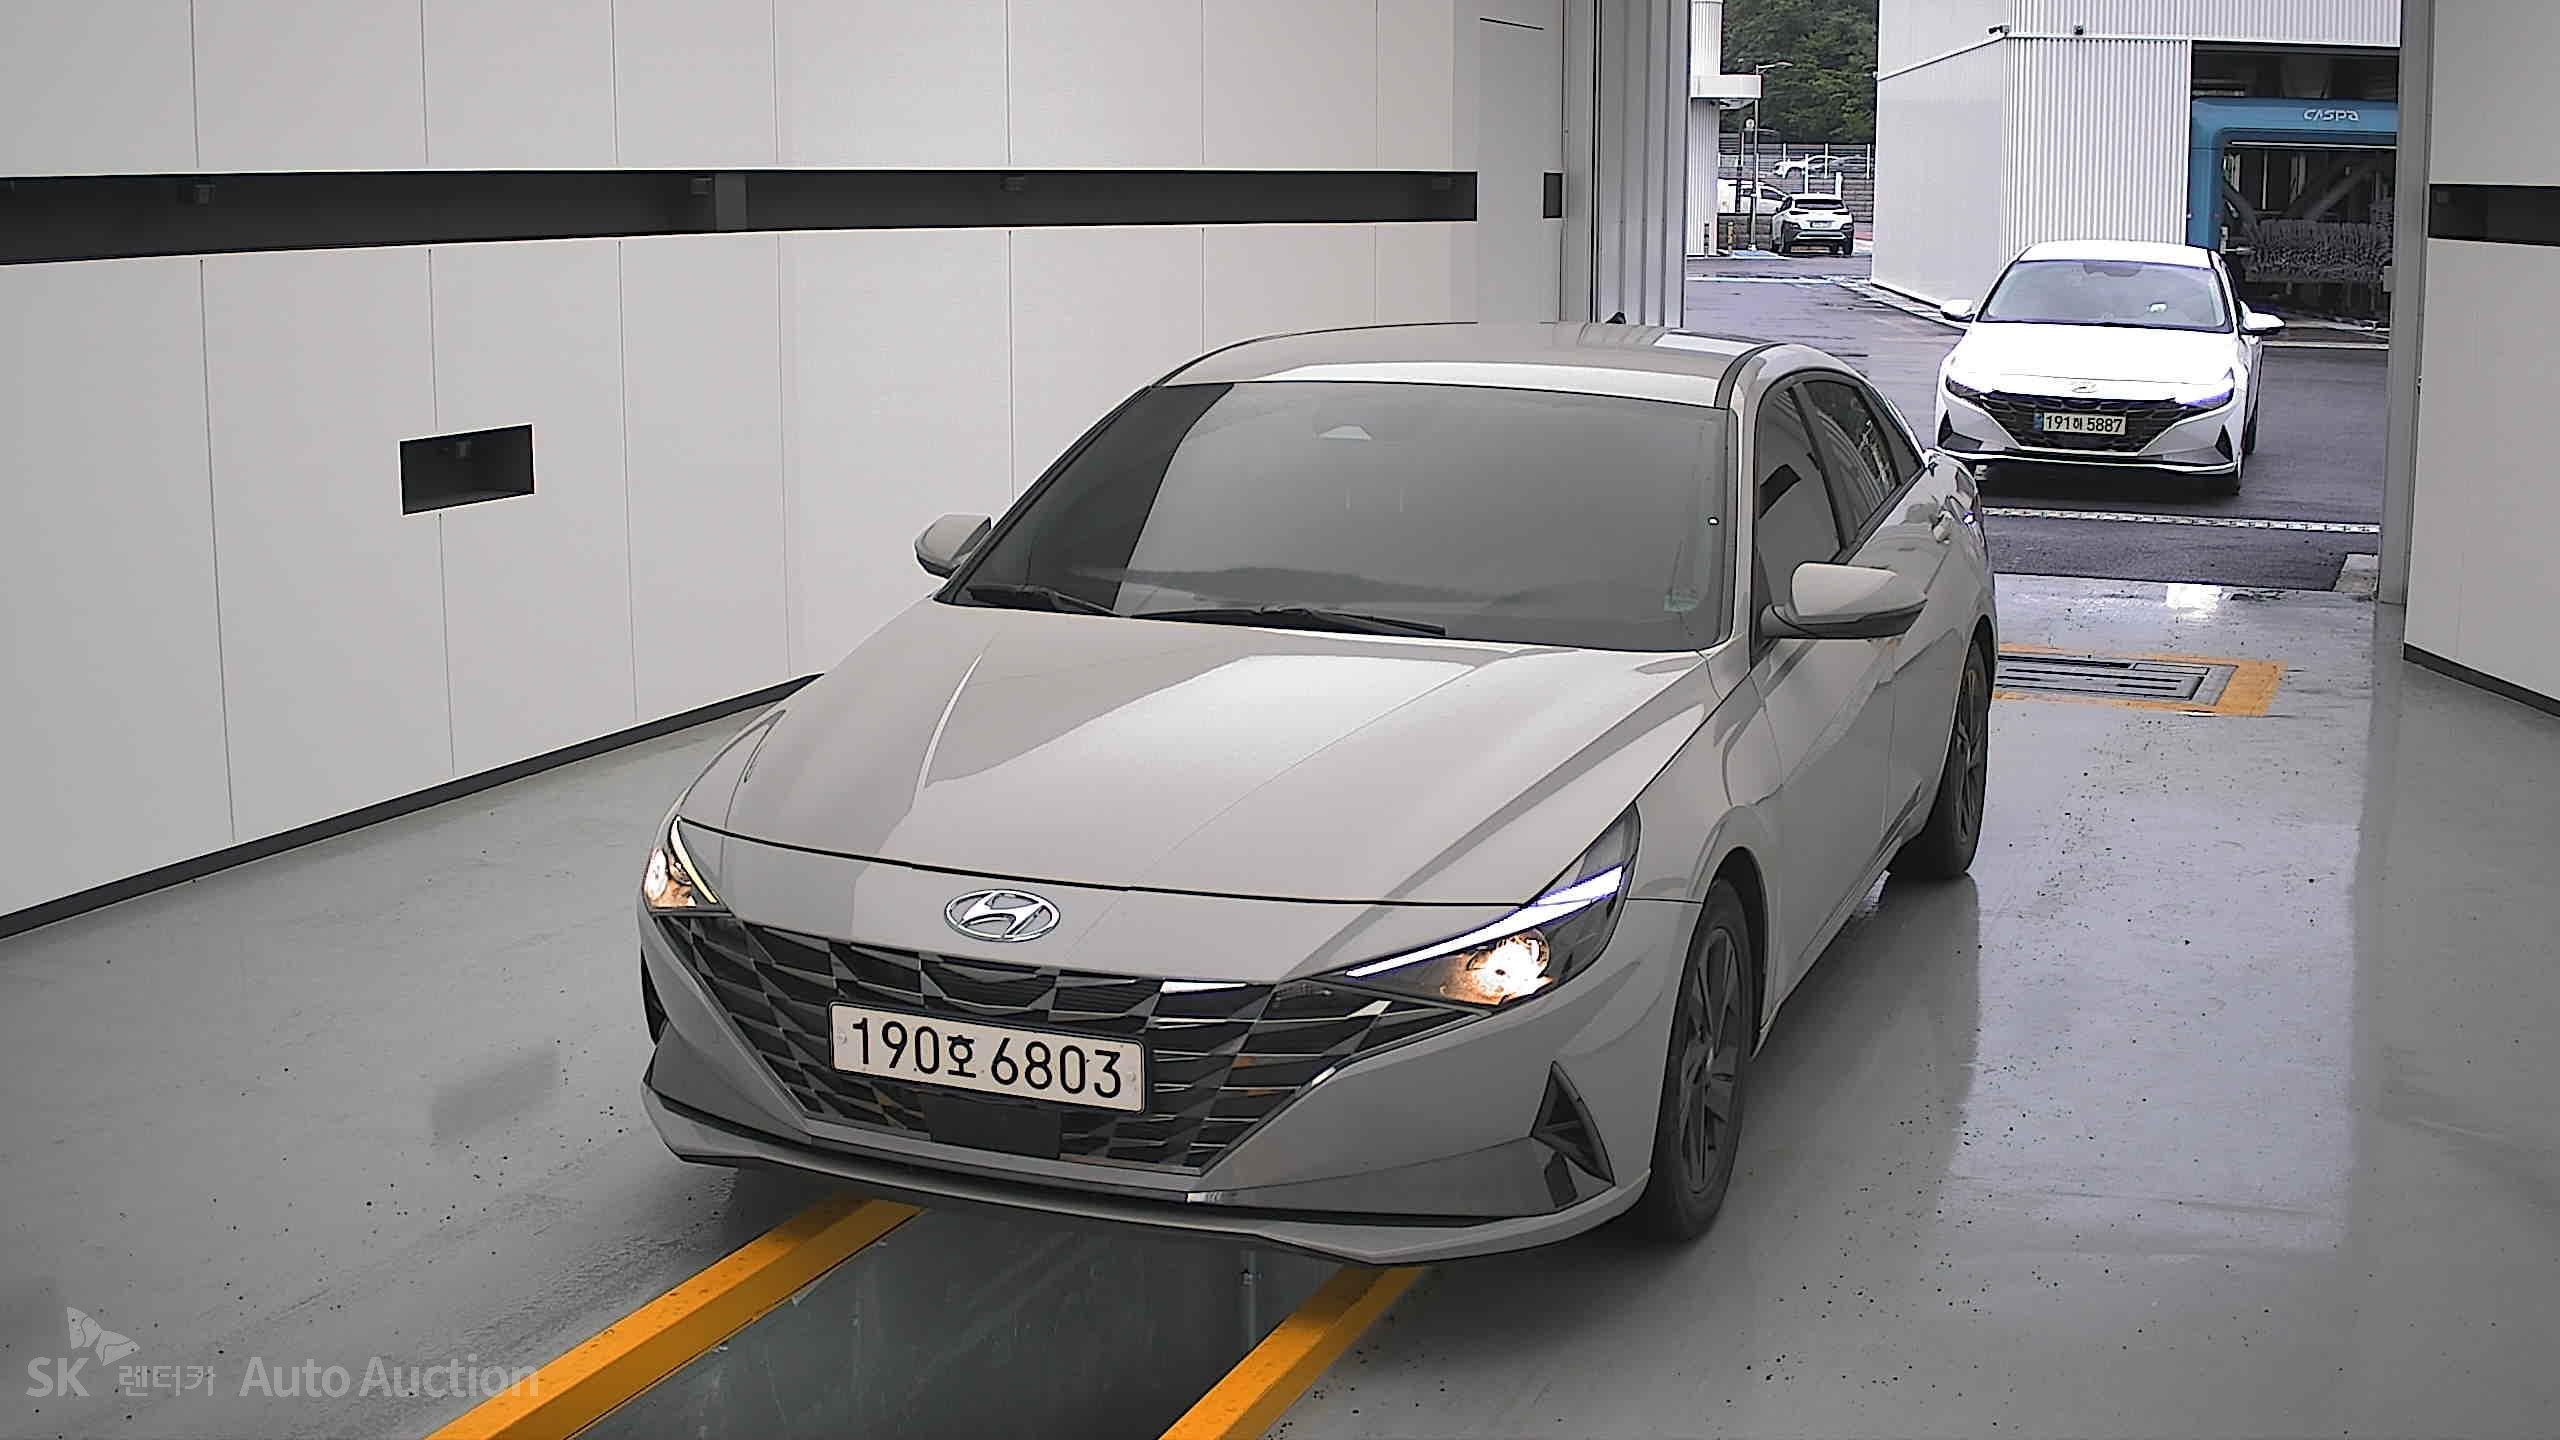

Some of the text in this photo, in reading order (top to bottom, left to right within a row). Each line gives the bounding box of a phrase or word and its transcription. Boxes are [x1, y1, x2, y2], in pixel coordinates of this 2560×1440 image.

[2086, 417, 2122, 432] 5887
[853, 1017, 1121, 1098] 190호 6803
